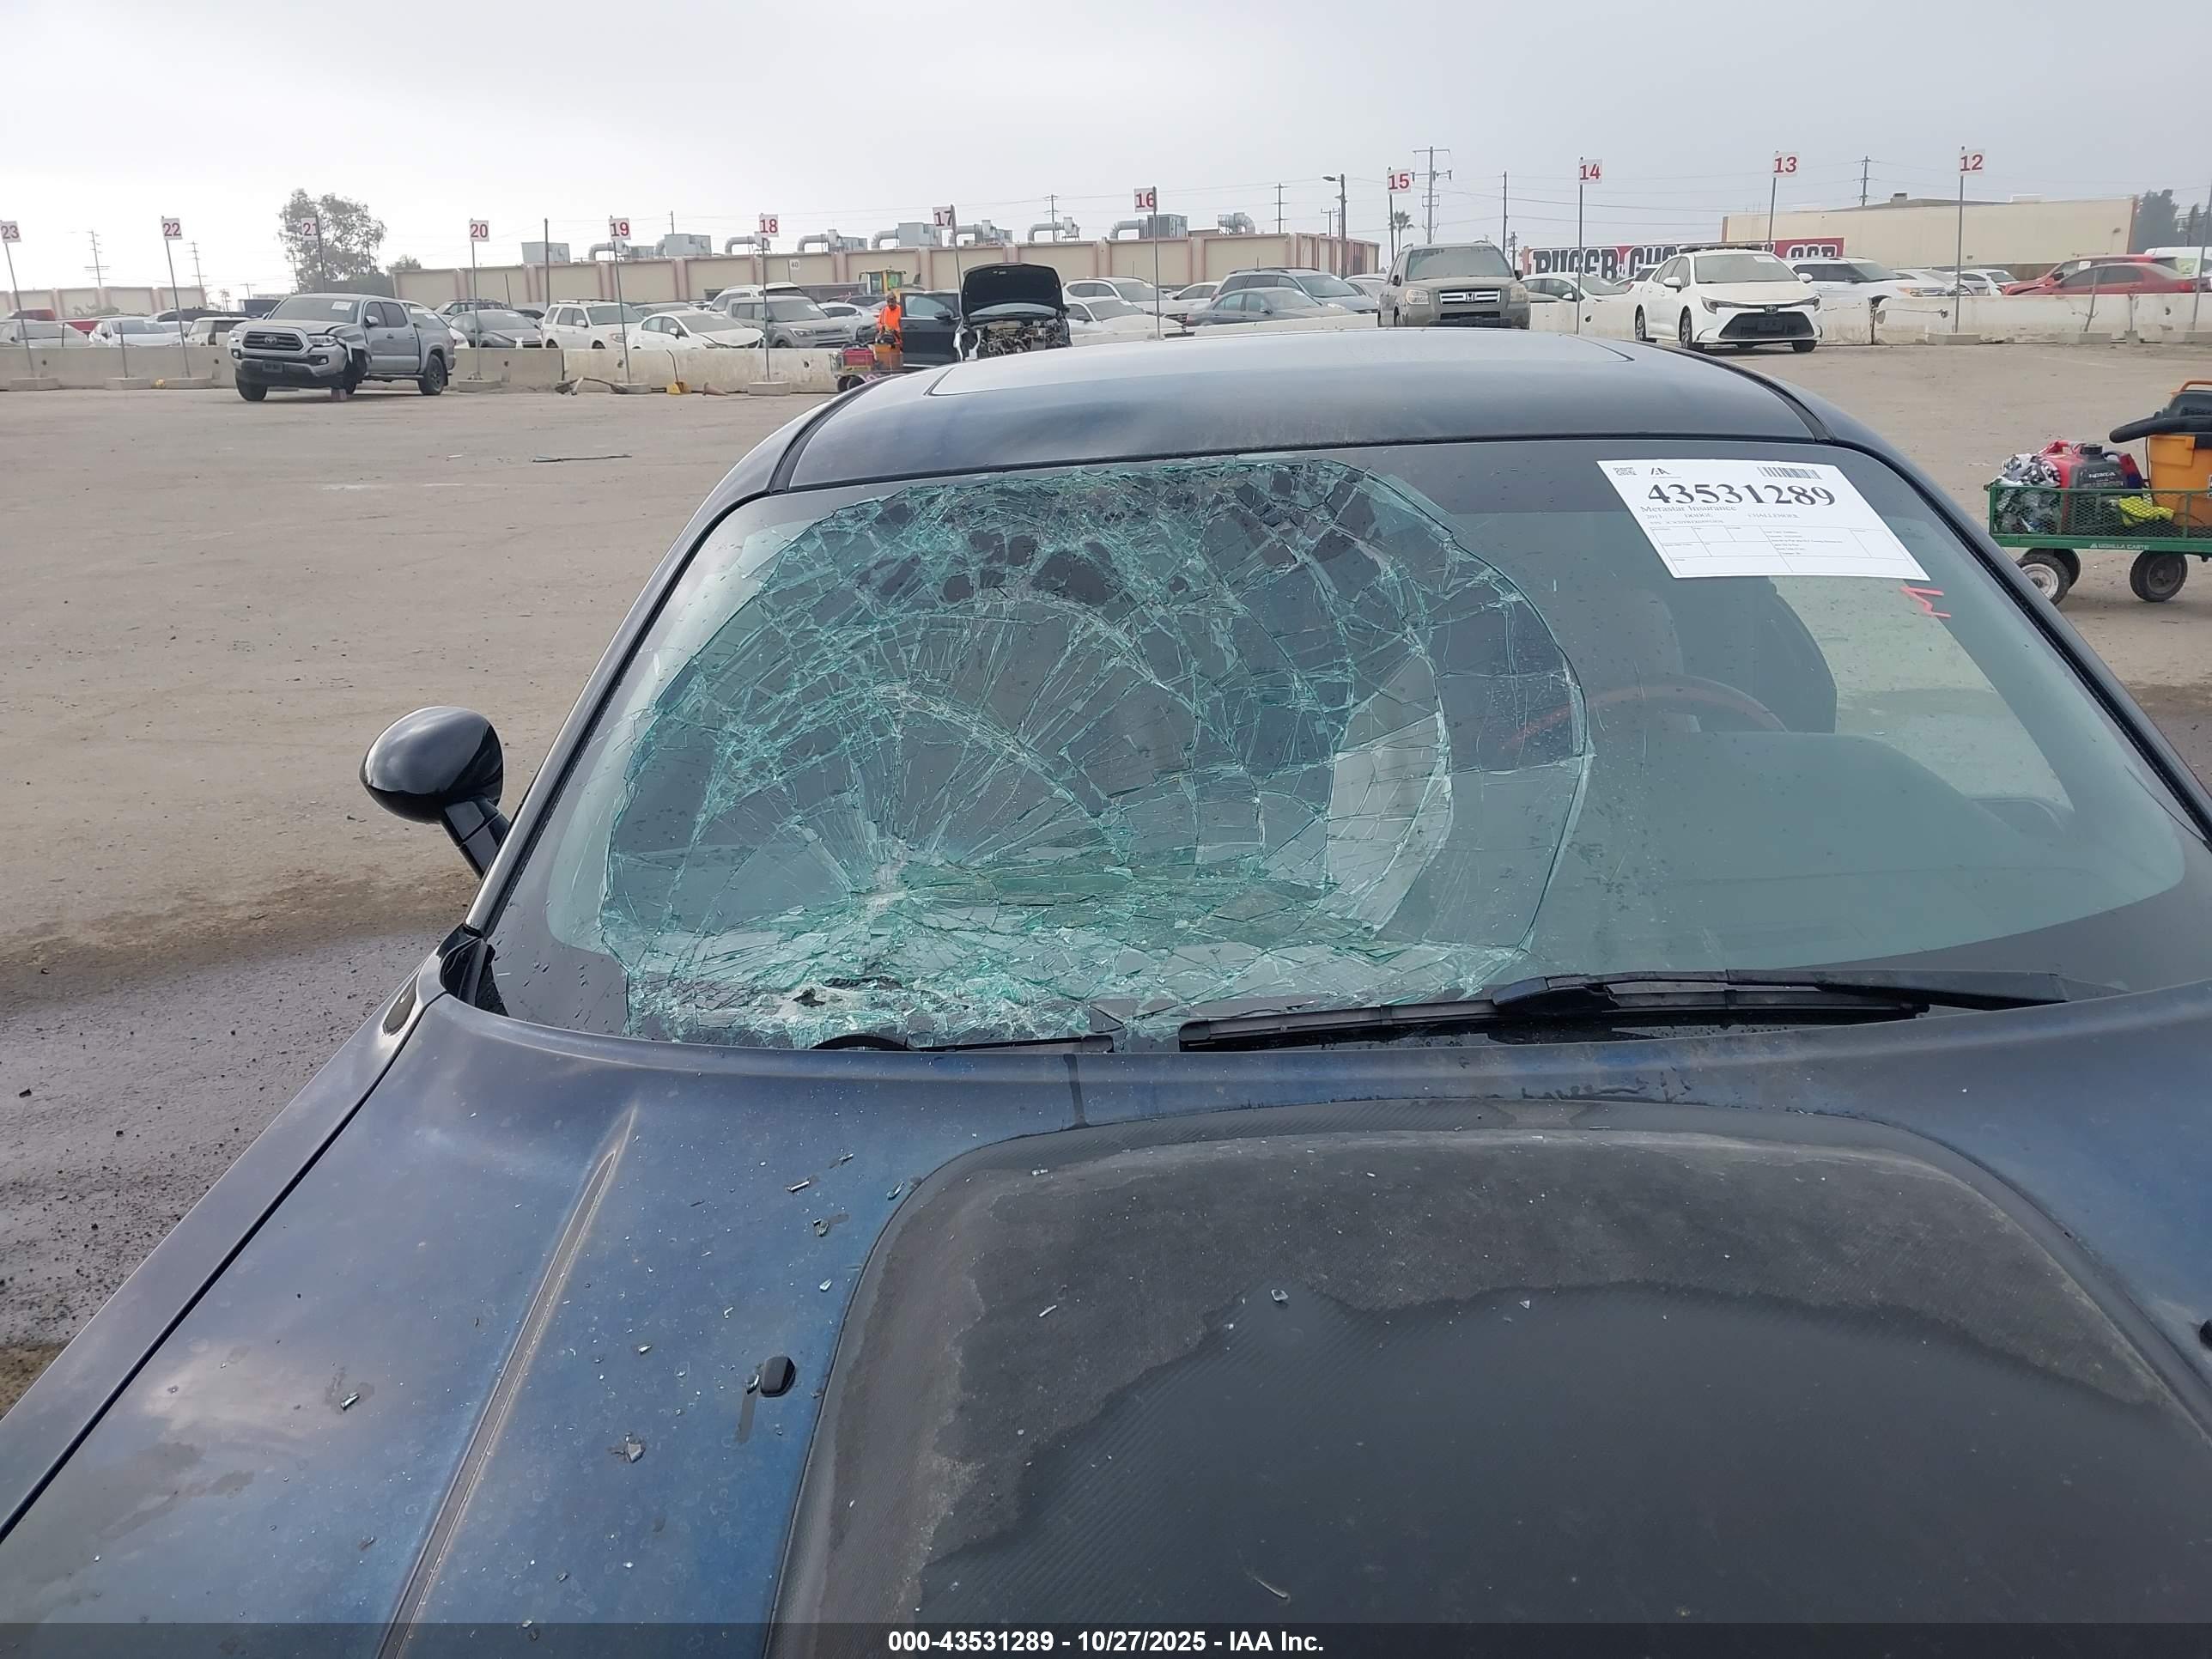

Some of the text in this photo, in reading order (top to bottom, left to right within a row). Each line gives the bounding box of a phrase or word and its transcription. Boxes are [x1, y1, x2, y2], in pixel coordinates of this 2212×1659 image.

[1579, 163, 1601, 180] 14
[1773, 156, 1797, 173] 13
[1960, 154, 1983, 172] 12
[1388, 173, 1410, 190] 15
[1135, 191, 1156, 208] 16
[760, 218, 778, 234] 18
[934, 210, 953, 227] 17
[0, 225, 20, 240] 23
[162, 222, 181, 237] 22
[302, 222, 318, 236] 21
[470, 223, 489, 238] 20
[610, 222, 629, 237] 19
[1648, 483, 1836, 507] 43531289
